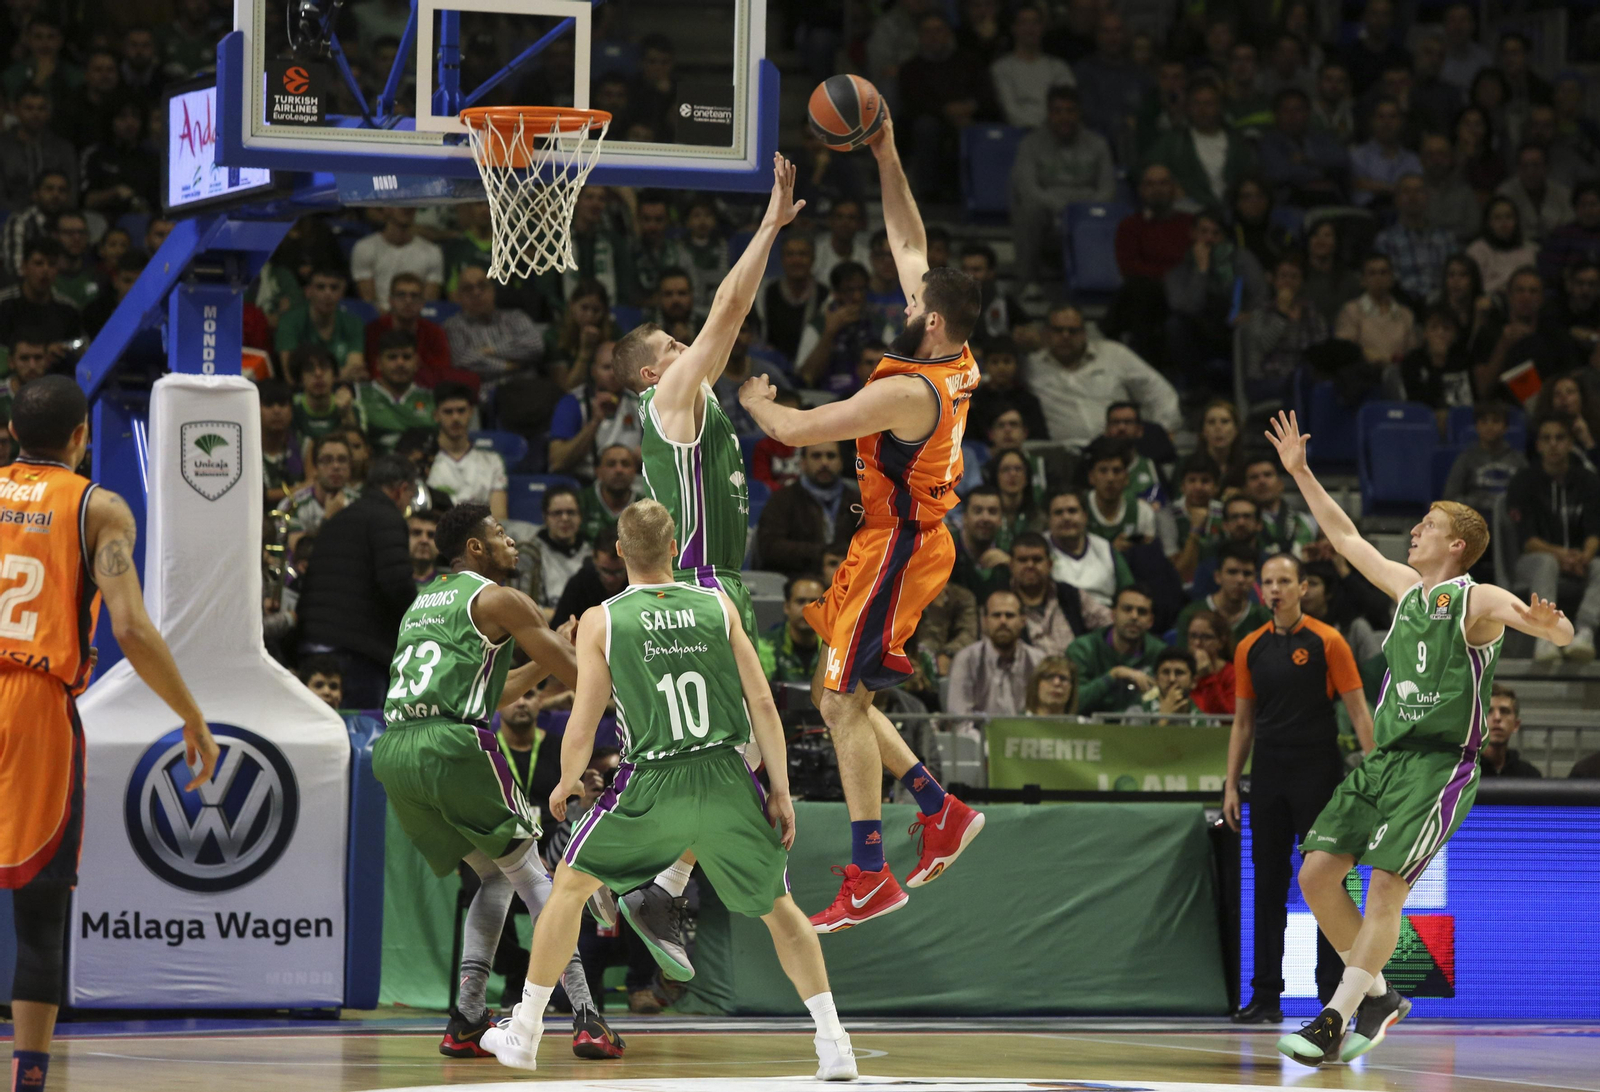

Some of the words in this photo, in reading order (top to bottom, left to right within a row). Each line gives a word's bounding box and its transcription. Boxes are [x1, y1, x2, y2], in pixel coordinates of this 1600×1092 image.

[274, 95, 318, 105] TURKISH
[274, 104, 318, 114] AIRLINES
[273, 112, 318, 123] EuroLeague
[693, 110, 732, 118] oneteam
[373, 175, 398, 190] MONDO
[202, 305, 217, 375] MONDO
[194, 459, 228, 470] Unicaja
[411, 589, 459, 611] BROOKS
[640, 608, 696, 631] SALIN
[1416, 640, 1427, 673] 9
[656, 670, 710, 741] 10
[1005, 737, 1102, 761] FRENTE
[1369, 823, 1388, 850] 9
[82, 911, 205, 947] Málaga
[215, 912, 333, 946] Wagen
